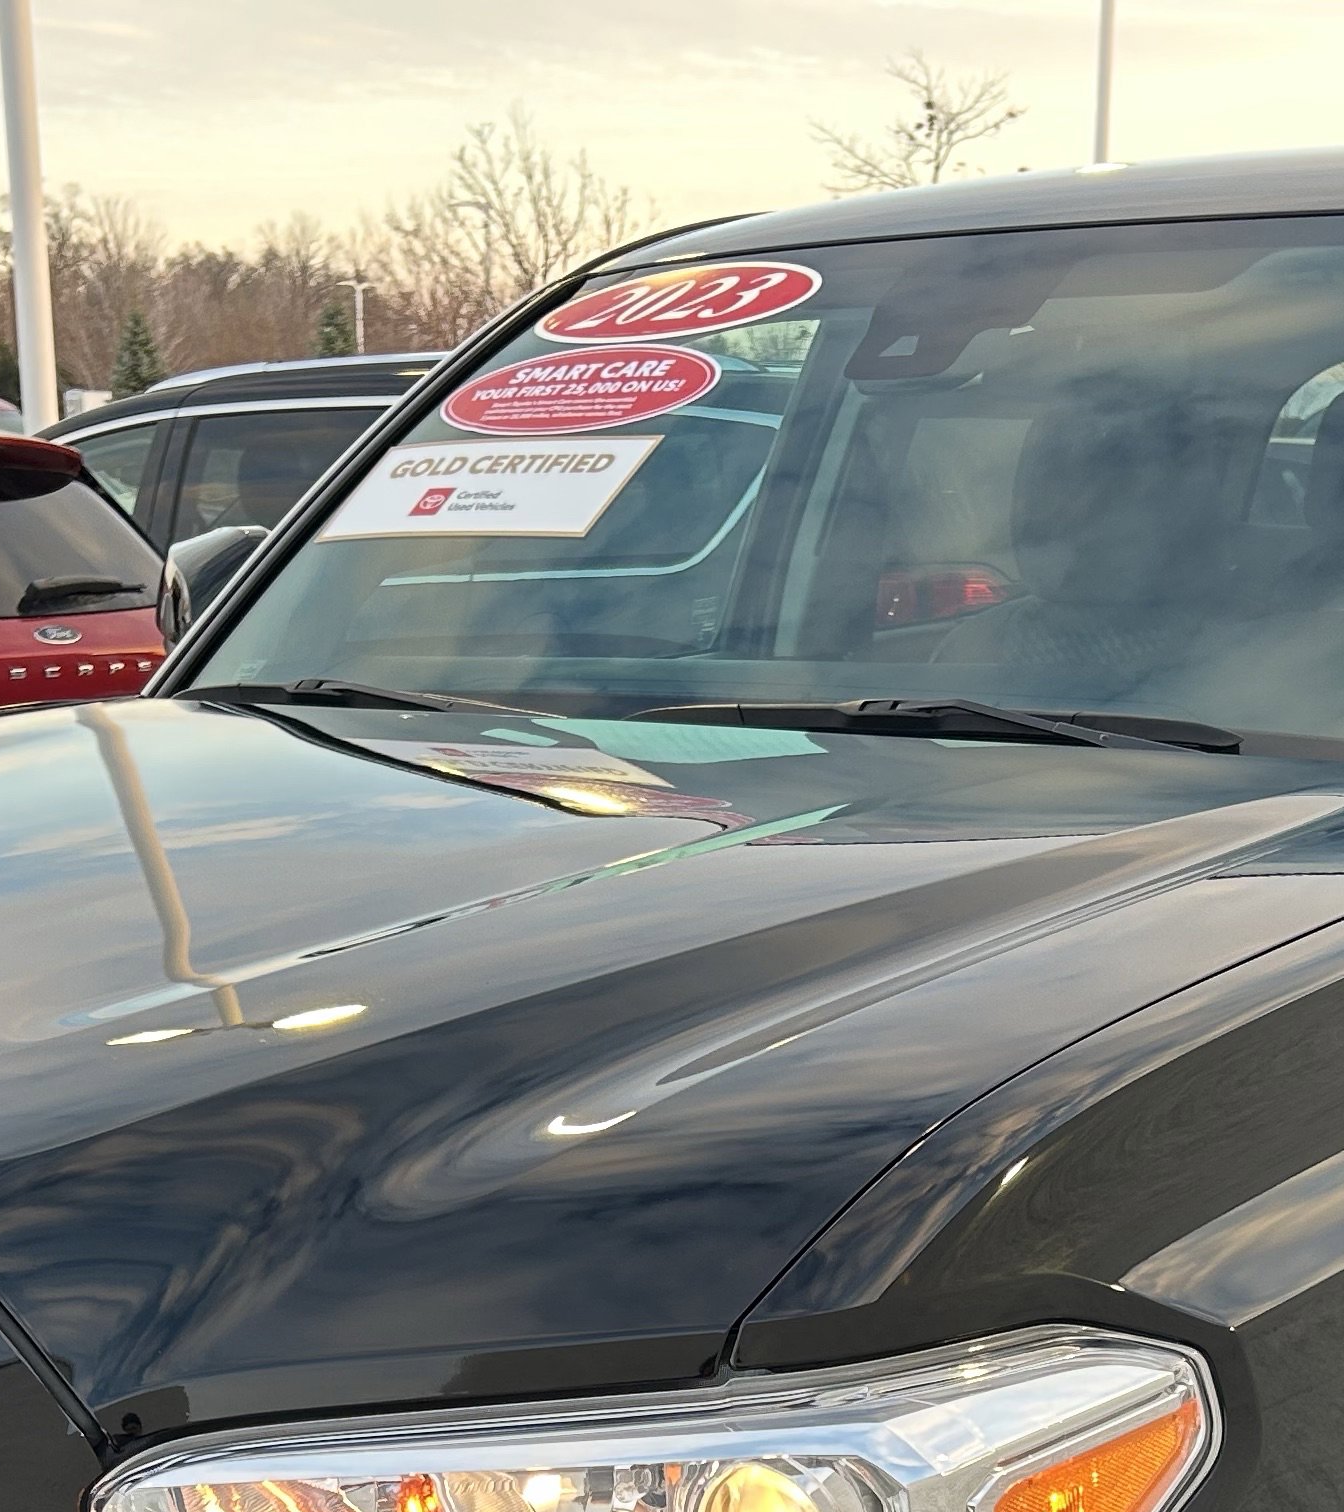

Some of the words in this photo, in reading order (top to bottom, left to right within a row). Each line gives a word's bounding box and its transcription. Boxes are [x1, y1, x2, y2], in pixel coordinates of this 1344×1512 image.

[565, 272, 788, 331] 2023
[509, 362, 603, 385] SMART
[600, 359, 677, 379] CARE
[471, 386, 520, 402] YOUR
[518, 383, 565, 397] FIRST
[561, 381, 623, 396] 25,000
[622, 380, 656, 393] ON
[654, 379, 687, 392] US!
[390, 456, 469, 479] GOLD
[468, 453, 616, 475] CERTIFIED
[447, 503, 473, 512] Used
[474, 502, 517, 511] Vehicles
[456, 490, 504, 500] Certified
